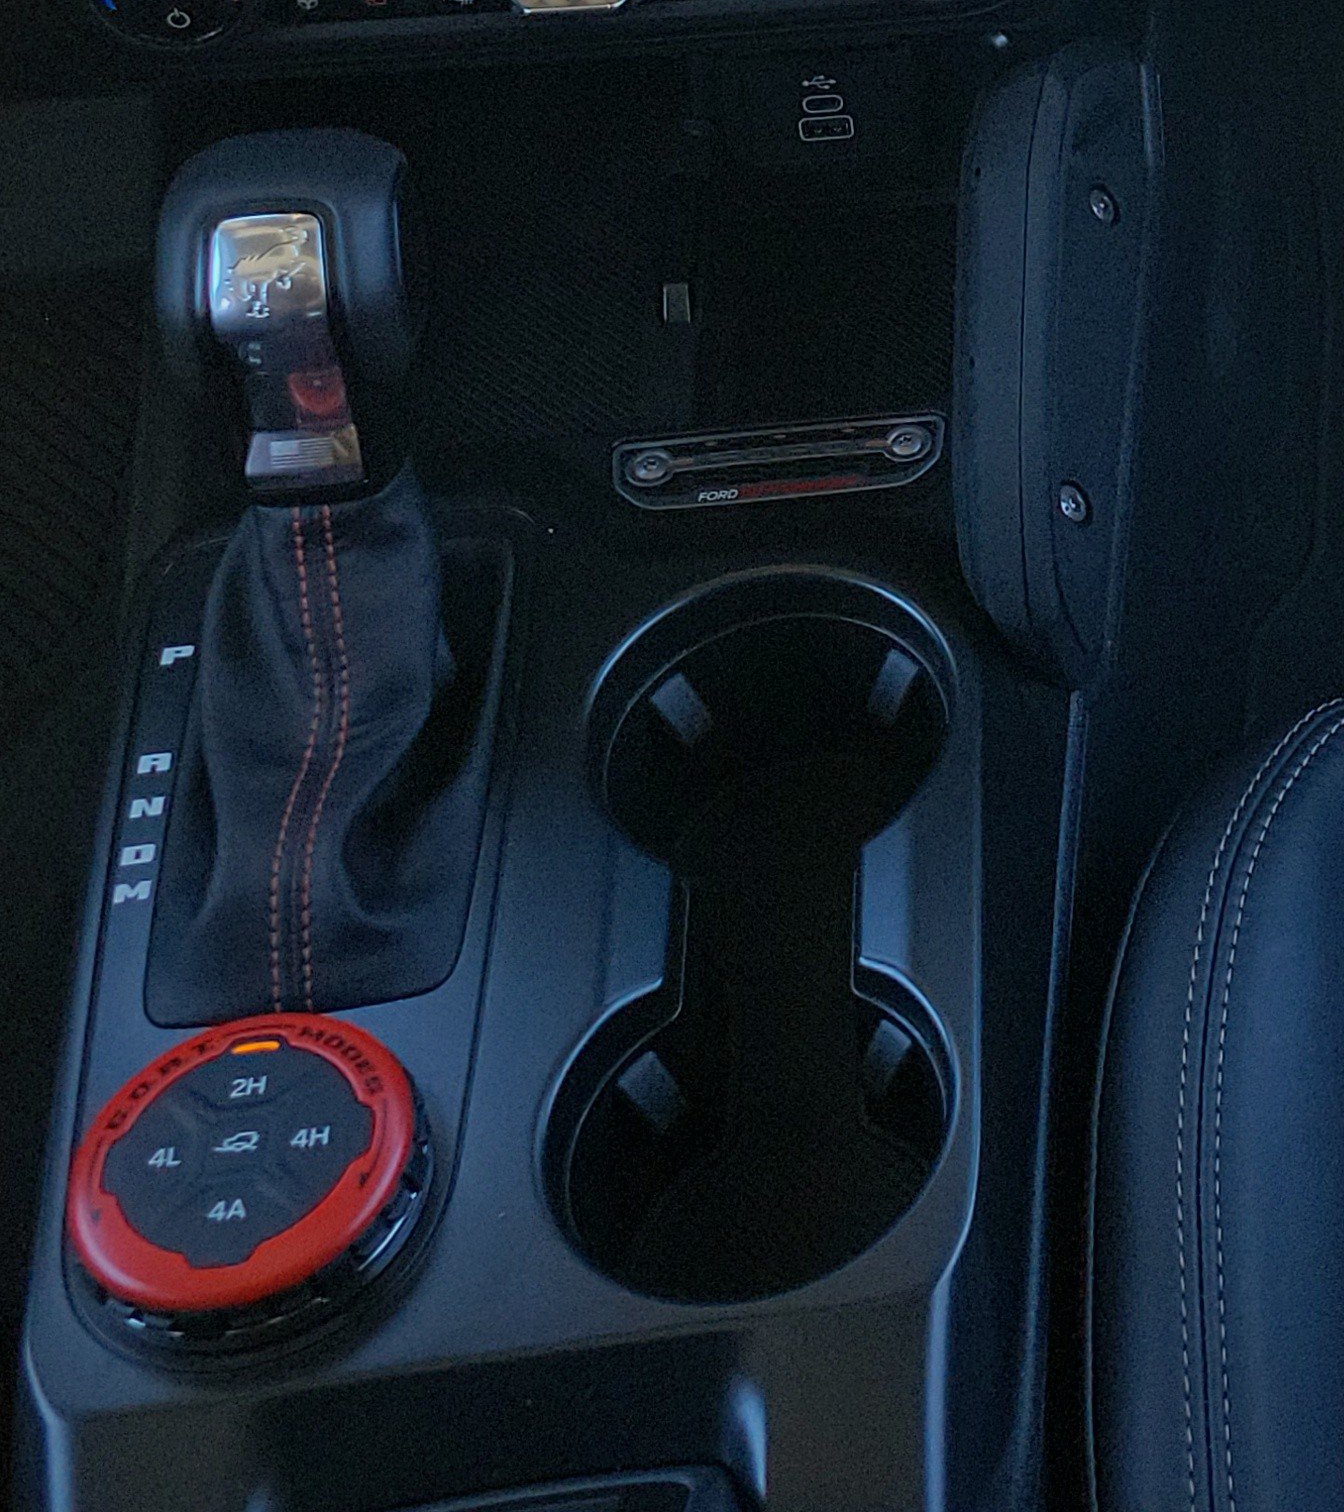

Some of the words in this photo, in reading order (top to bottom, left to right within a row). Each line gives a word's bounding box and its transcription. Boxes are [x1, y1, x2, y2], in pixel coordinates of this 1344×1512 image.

[698, 489, 739, 502] FORD
[160, 644, 195, 666] P
[129, 796, 164, 819] N
[119, 843, 156, 866] D
[112, 880, 152, 904] M
[230, 1076, 267, 1099] 2H
[290, 1125, 330, 1148] 4H
[148, 1148, 181, 1168] 4L
[207, 1198, 246, 1221] 4A
